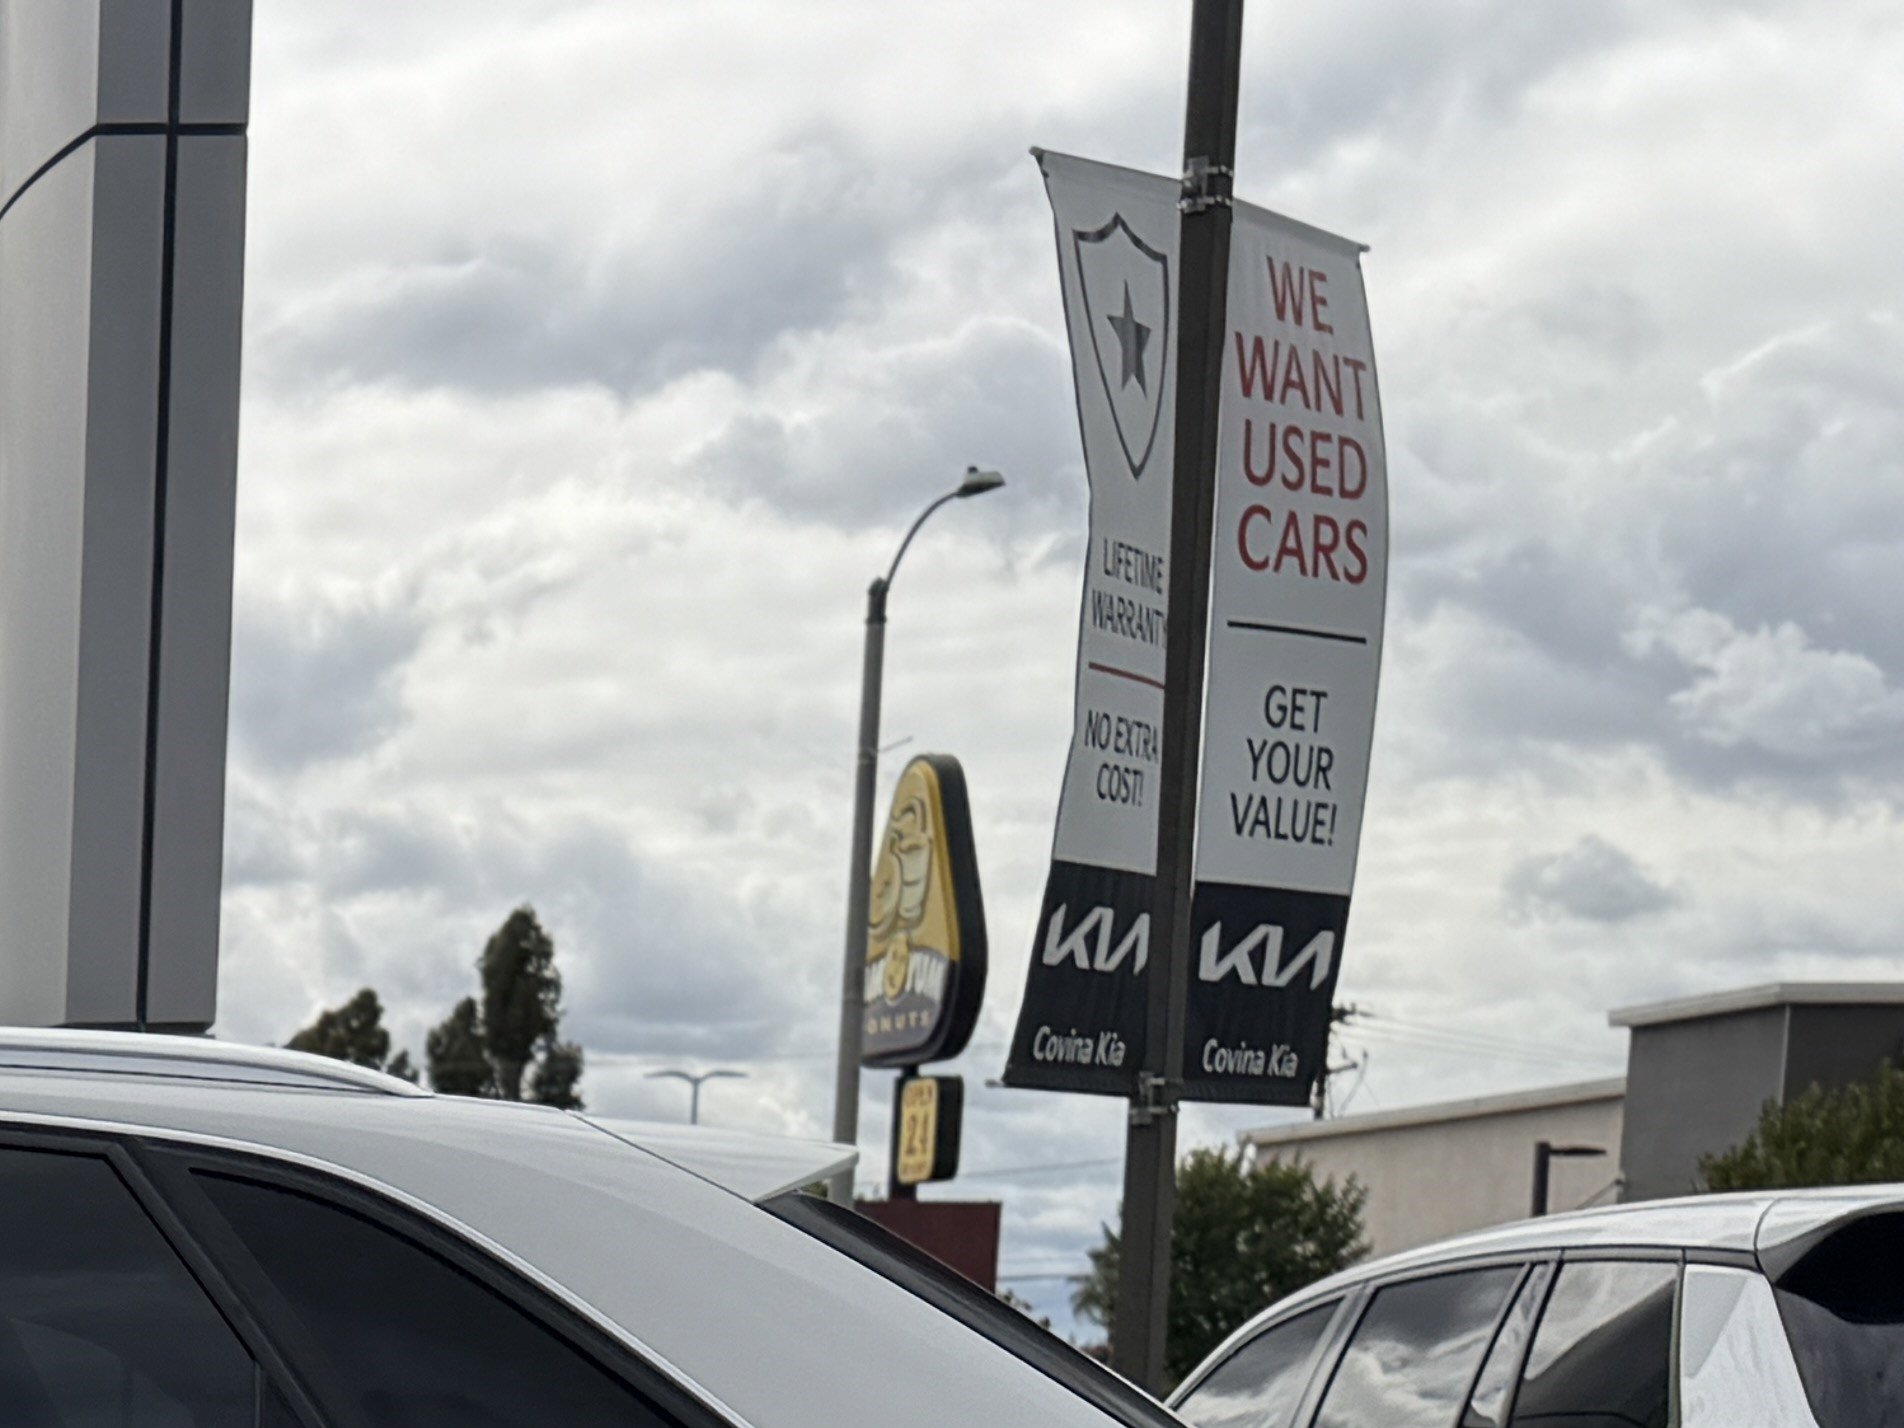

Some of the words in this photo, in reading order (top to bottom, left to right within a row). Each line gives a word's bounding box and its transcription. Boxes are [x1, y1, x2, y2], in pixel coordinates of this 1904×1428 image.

[1266, 254, 1333, 336] WE
[1234, 330, 1367, 422] WANT
[1244, 418, 1368, 500] USED
[1103, 536, 1163, 595] LIFETIME
[1237, 503, 1368, 585] CARS
[1084, 708, 1111, 750] NO
[1114, 715, 1159, 764] EXTRA
[1264, 684, 1328, 733] GET
[1096, 762, 1144, 807] COST!
[1247, 737, 1334, 792] YOUR
[1229, 791, 1338, 847] VALUE!
[866, 1009, 930, 1035] ONUTS
[1032, 1025, 1094, 1065] Covina
[1094, 1030, 1127, 1067] Kia
[1201, 1037, 1265, 1076] Covina
[1266, 1043, 1299, 1078] Kia
